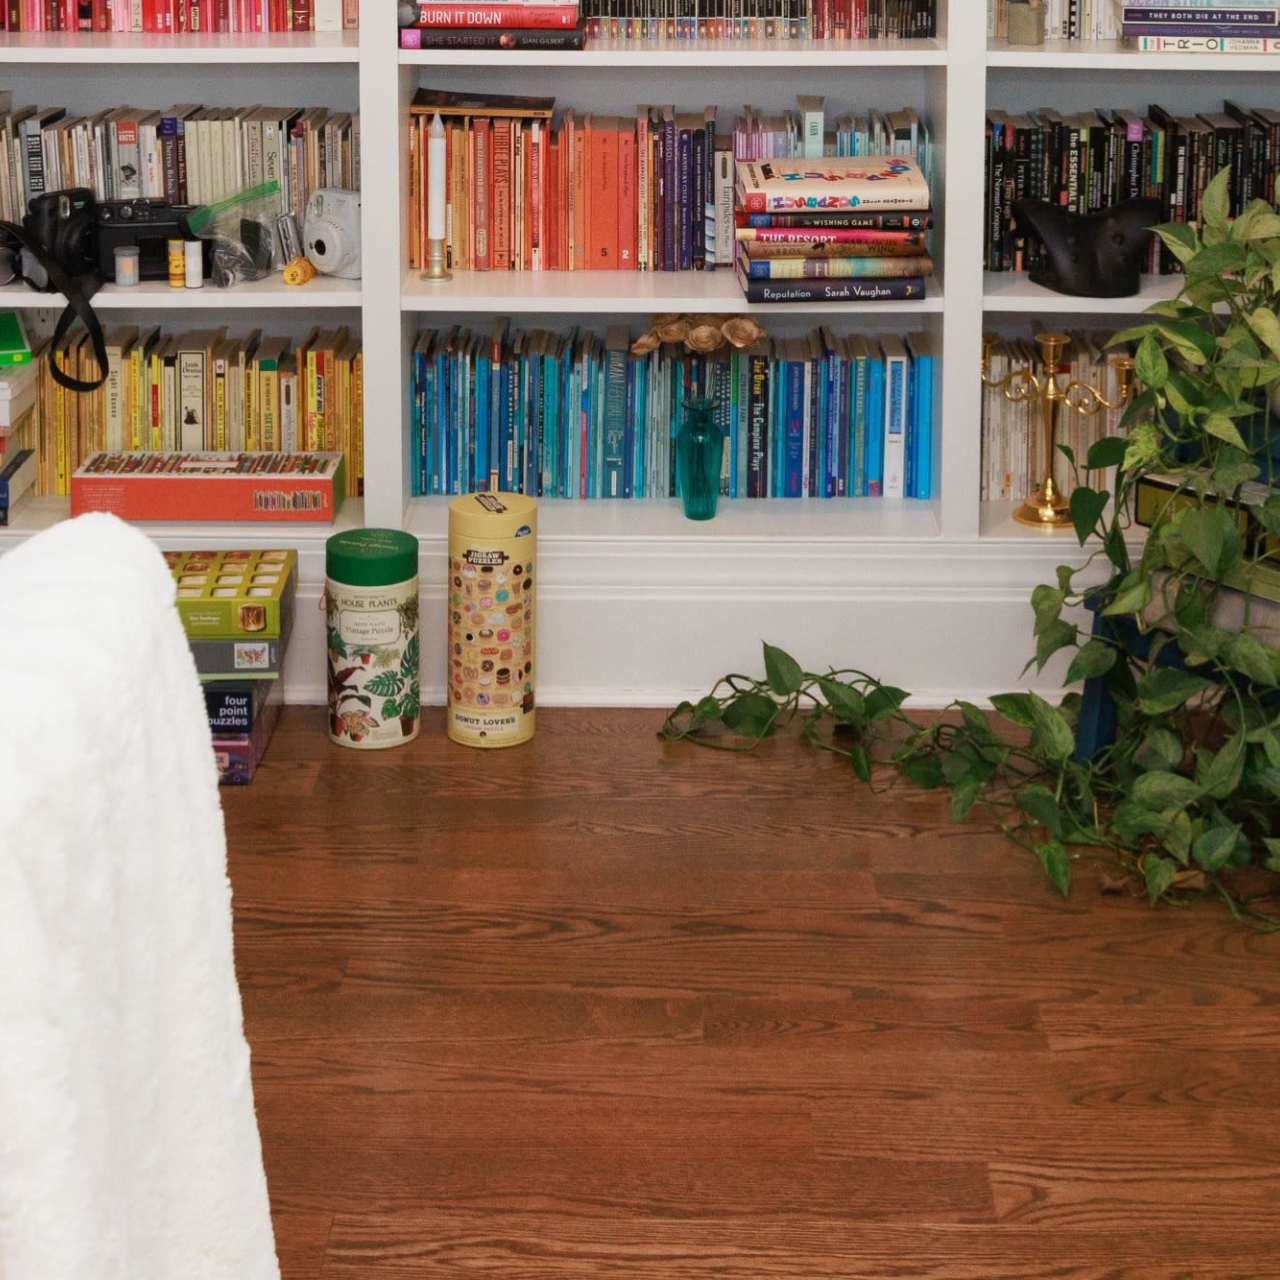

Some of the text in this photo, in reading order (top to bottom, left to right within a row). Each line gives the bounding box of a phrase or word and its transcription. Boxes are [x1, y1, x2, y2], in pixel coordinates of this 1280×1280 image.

[420, 10, 502, 25] BURN IT DOWN
[1148, 13, 1260, 21] THEY BOTH DIE AT THE END
[665, 126, 674, 163] MARISOL
[495, 130, 510, 184] THREE PLAYS
[266, 151, 278, 179] Seven
[1068, 132, 1079, 202] the ESSENTIAL
[1129, 143, 1140, 186] Christopher
[721, 185, 732, 225] Euripides
[772, 195, 860, 209] HUSBANDS
[813, 219, 873, 227] WISHING GAME
[763, 286, 892, 300] Reputation Sarah Vaughan
[751, 360, 765, 472] Joe Orton The Complete Plays
[264, 413, 273, 440] SIXTIES
[341, 599, 398, 609] HOUSE PLANTS
[344, 625, 369, 635] Vintage
[225, 695, 249, 705] four
[219, 706, 249, 717] point
[482, 717, 516, 726] LOVERS
